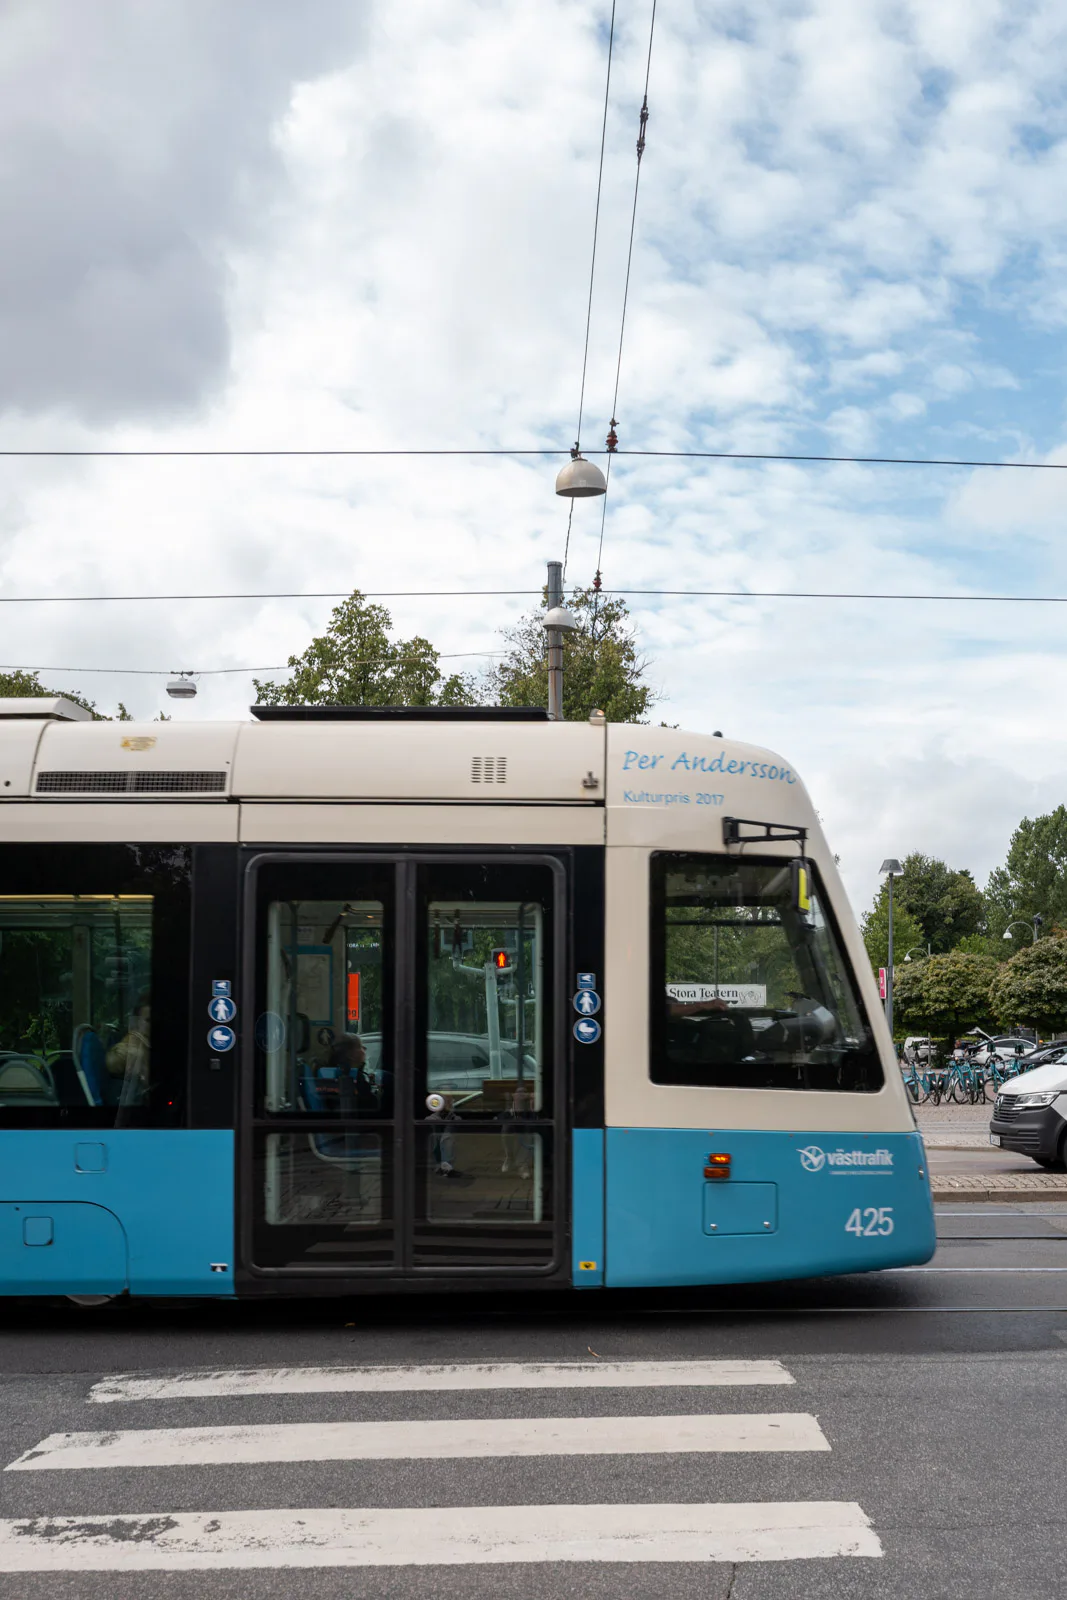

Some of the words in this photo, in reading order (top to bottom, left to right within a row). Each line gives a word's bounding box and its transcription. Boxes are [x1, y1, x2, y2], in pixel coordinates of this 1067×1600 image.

[622, 750, 664, 771] Per
[671, 751, 797, 785] Andersson
[623, 790, 691, 806] Kulturpris
[696, 793, 725, 806] 2017
[669, 987, 697, 998] Stora
[699, 987, 739, 998] Teatern
[826, 1148, 894, 1166] västtrafik
[845, 1207, 894, 1237] 425
